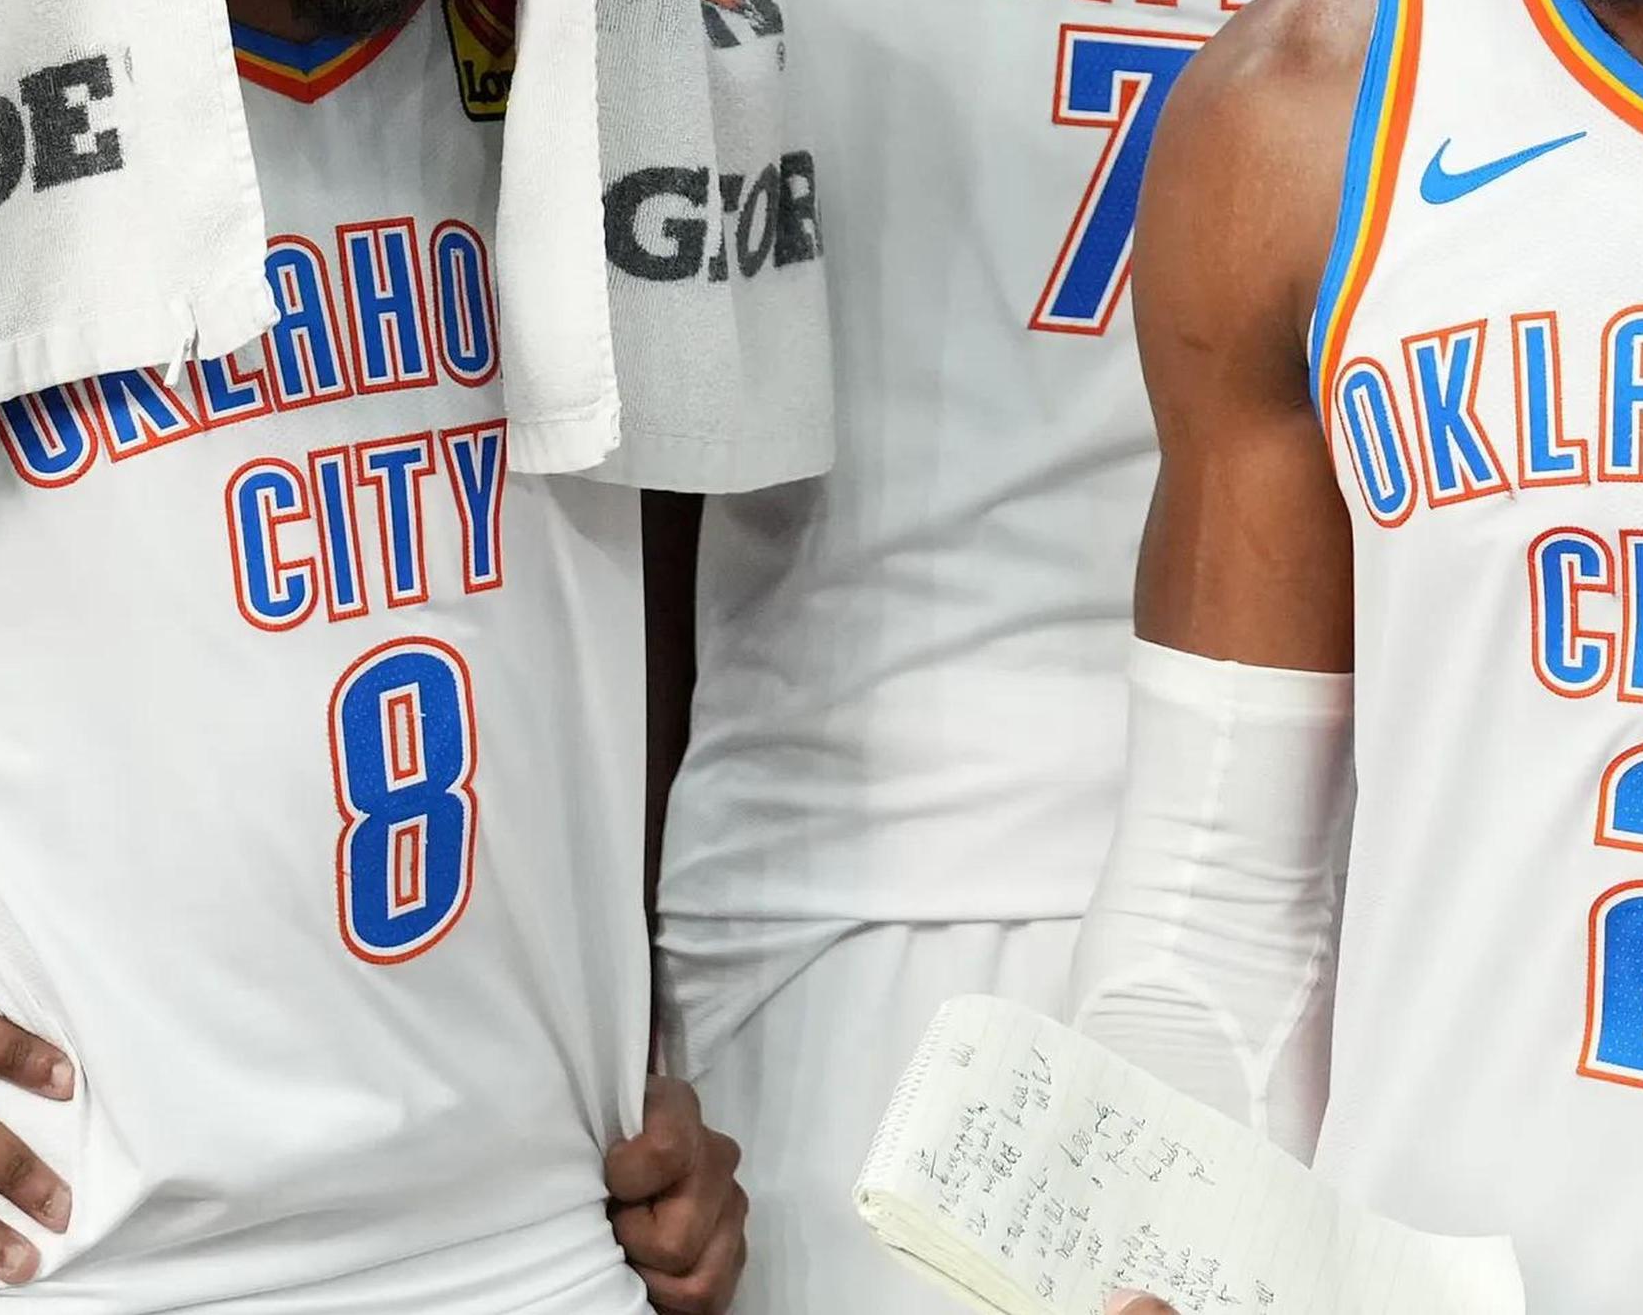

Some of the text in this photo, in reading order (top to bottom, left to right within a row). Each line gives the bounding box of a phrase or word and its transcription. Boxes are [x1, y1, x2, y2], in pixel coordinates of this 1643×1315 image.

[1028, 23, 1213, 336] 7
[225, 417, 508, 633] CITY
[327, 636, 476, 965] 8
